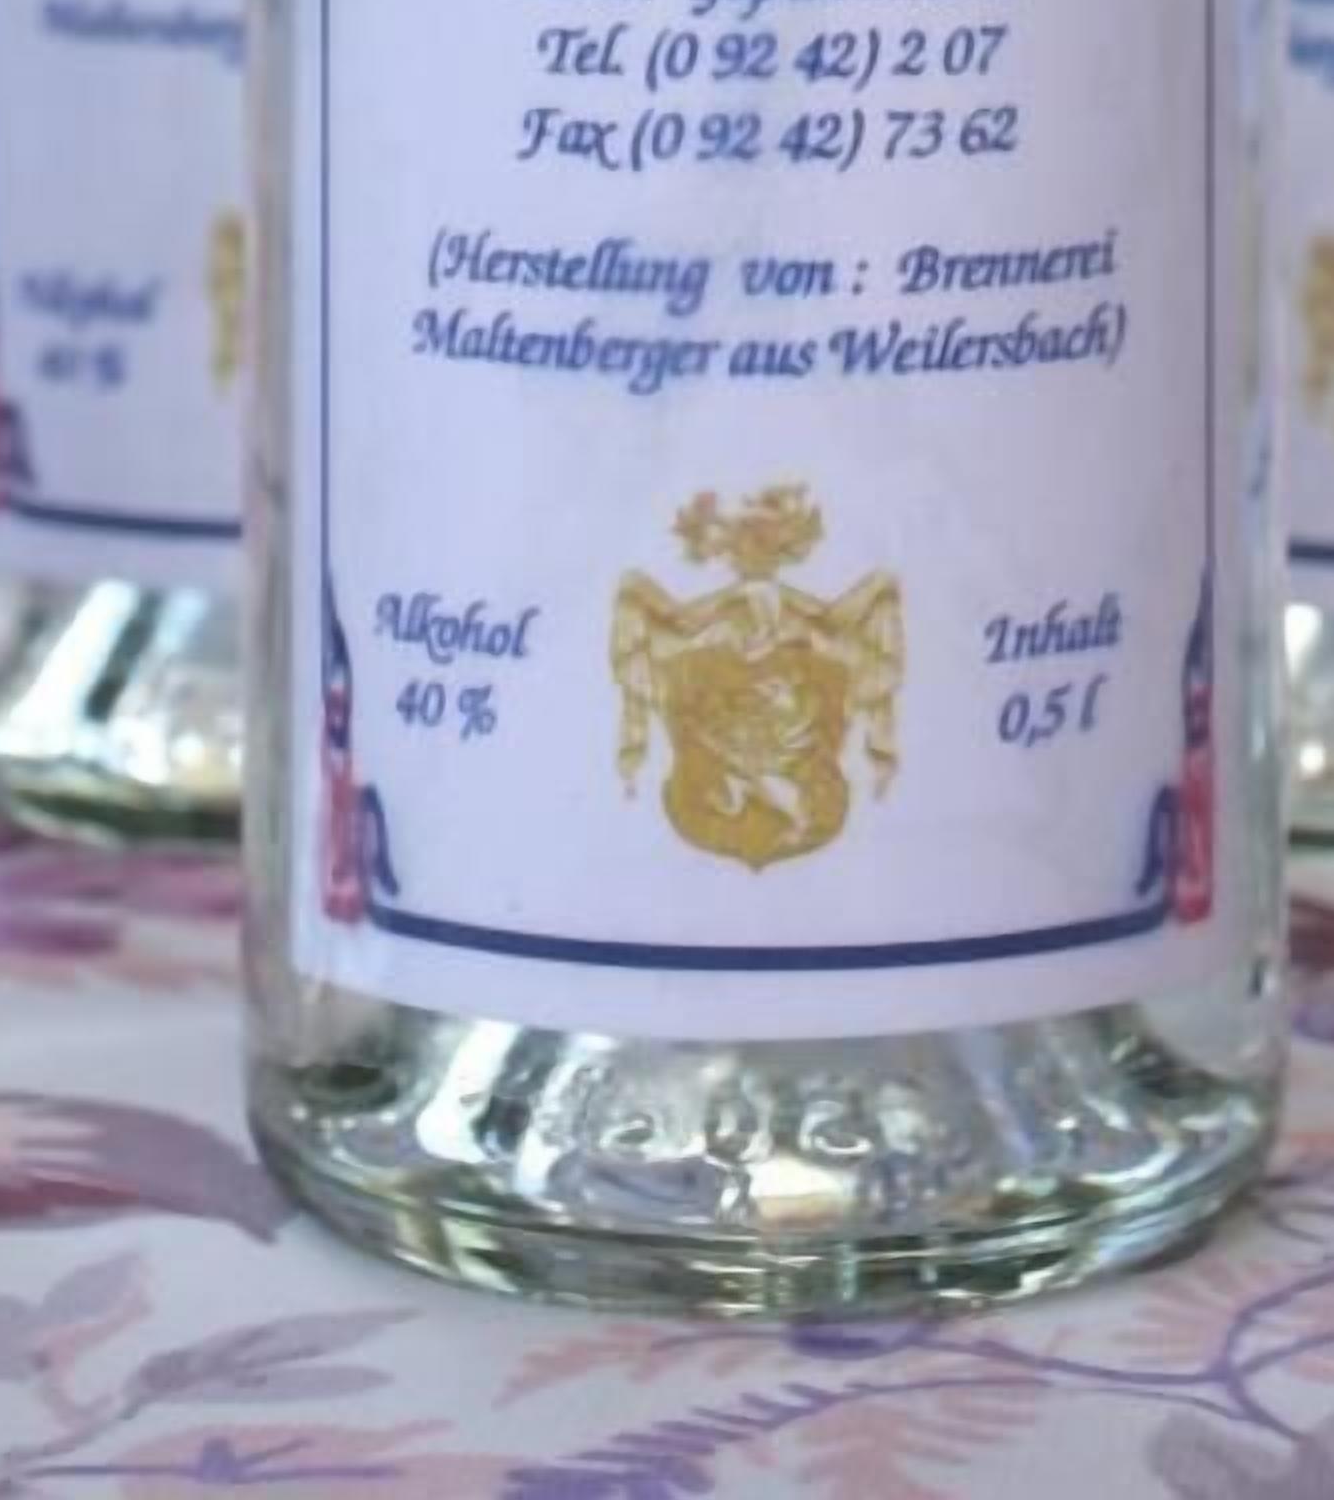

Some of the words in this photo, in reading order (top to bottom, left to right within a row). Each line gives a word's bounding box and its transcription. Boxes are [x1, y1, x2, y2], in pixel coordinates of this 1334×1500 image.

[536, 25, 626, 76] Tel.
[645, 32, 699, 92] (0
[709, 32, 778, 81] 92
[795, 32, 882, 90] 42)
[892, 30, 927, 76] 2
[943, 25, 1008, 76] 07
[517, 106, 619, 171] Fax
[630, 113, 684, 171] (0
[693, 113, 760, 161] 92
[780, 111, 864, 172] 42)
[885, 111, 944, 159] 73
[959, 106, 1018, 153] 62
[428, 227, 709, 317] (Herstellung
[741, 257, 832, 296] von
[899, 231, 1117, 294] Brennerei
[412, 310, 719, 396] Maltenberger
[728, 333, 816, 377] aus
[830, 305, 1127, 377] Weilersbach)
[375, 593, 539, 663] Alkohol
[985, 593, 1124, 663] Inhalt
[396, 683, 445, 725] 40
[458, 683, 496, 739] %
[998, 683, 1064, 748] 0,5
